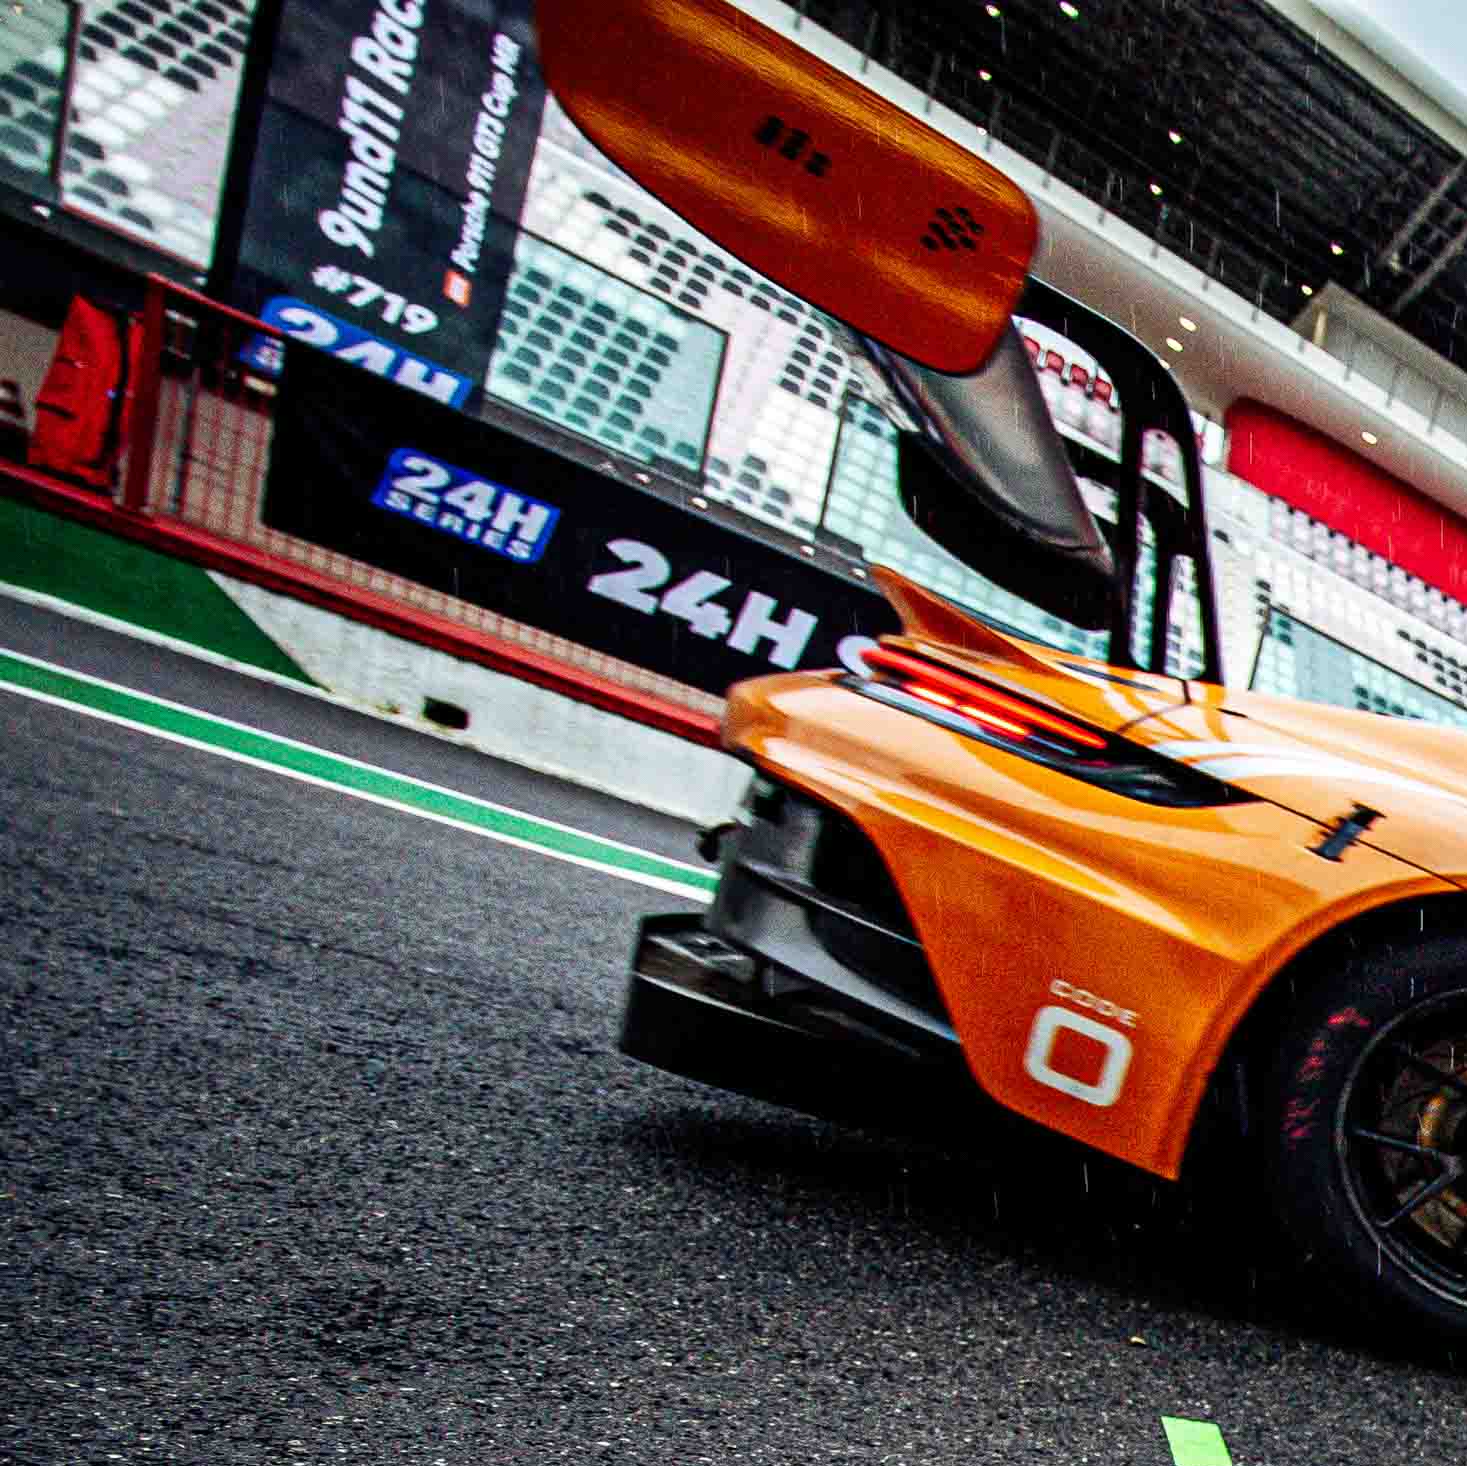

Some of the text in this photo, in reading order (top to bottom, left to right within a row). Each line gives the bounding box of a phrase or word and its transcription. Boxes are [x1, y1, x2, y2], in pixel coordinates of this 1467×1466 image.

[318, 74, 405, 258] 9und11
[310, 265, 440, 334] #719
[383, 489, 534, 561] SERIES
[391, 456, 551, 545] 24H
[587, 537, 819, 671] 24H
[1049, 978, 1140, 1029] CODE
